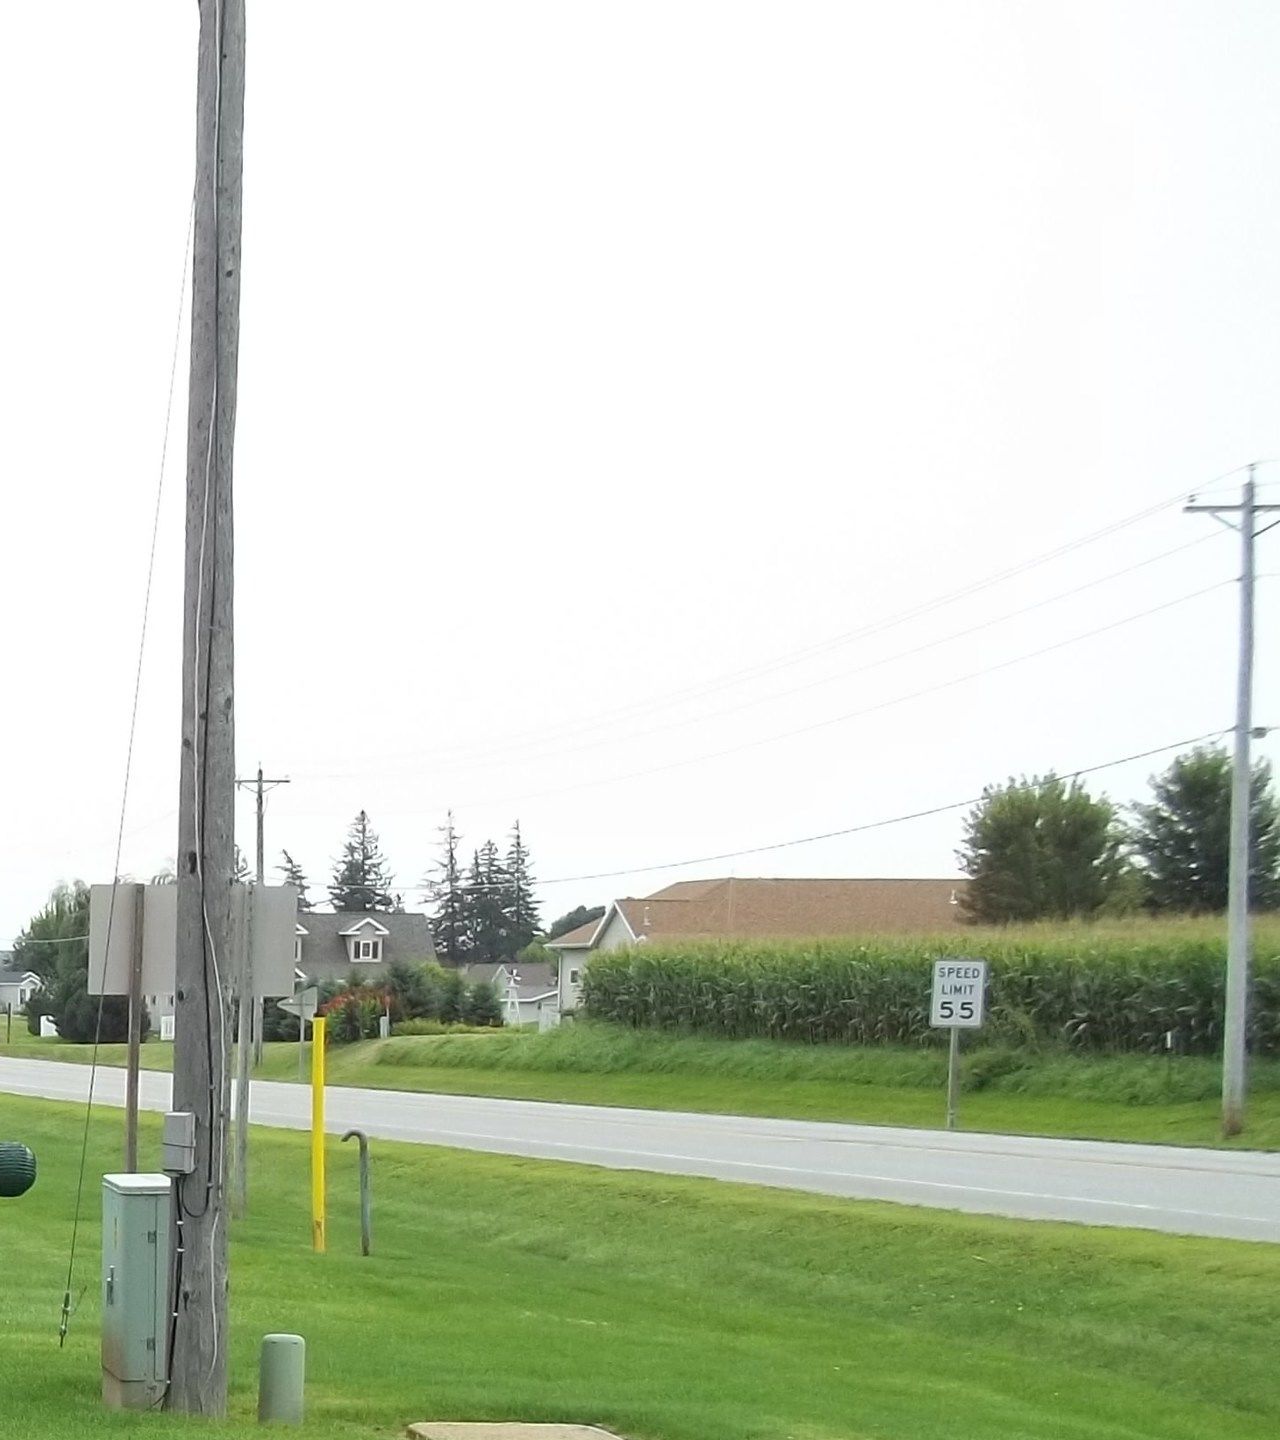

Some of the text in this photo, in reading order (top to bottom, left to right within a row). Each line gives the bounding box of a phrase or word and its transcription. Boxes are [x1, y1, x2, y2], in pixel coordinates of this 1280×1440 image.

[938, 967, 980, 979] SPEED
[941, 984, 974, 995] LIMIT
[940, 1001, 974, 1019] 55
